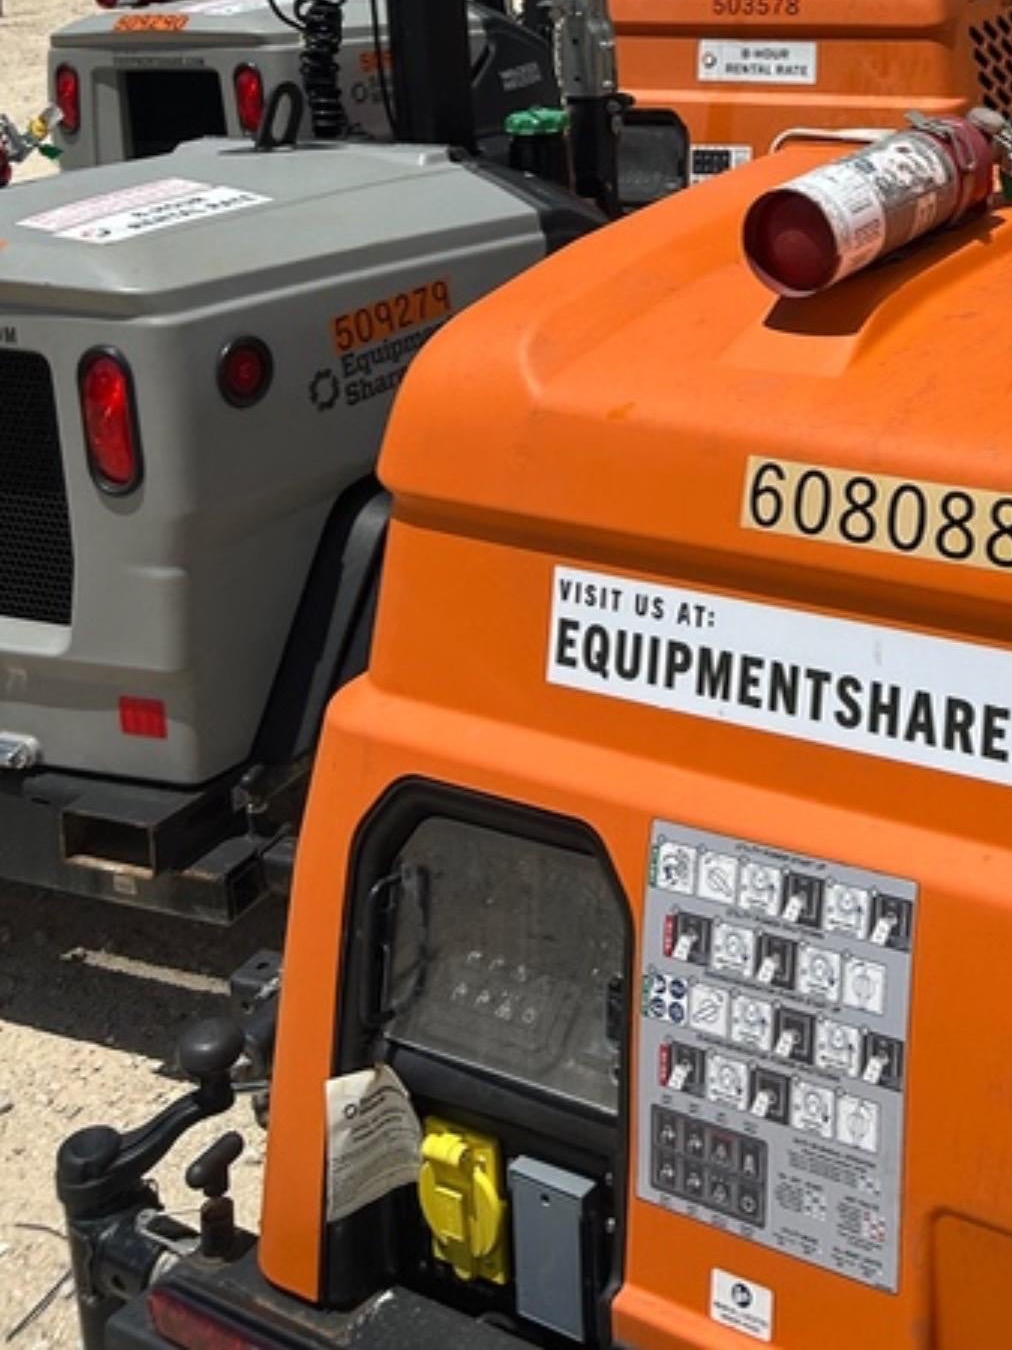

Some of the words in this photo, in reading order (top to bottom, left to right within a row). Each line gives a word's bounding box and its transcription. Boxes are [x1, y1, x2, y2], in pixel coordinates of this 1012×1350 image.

[333, 280, 452, 352] 509279
[559, 578, 622, 613] VISIT
[634, 594, 664, 622] US
[676, 601, 716, 629] AT:
